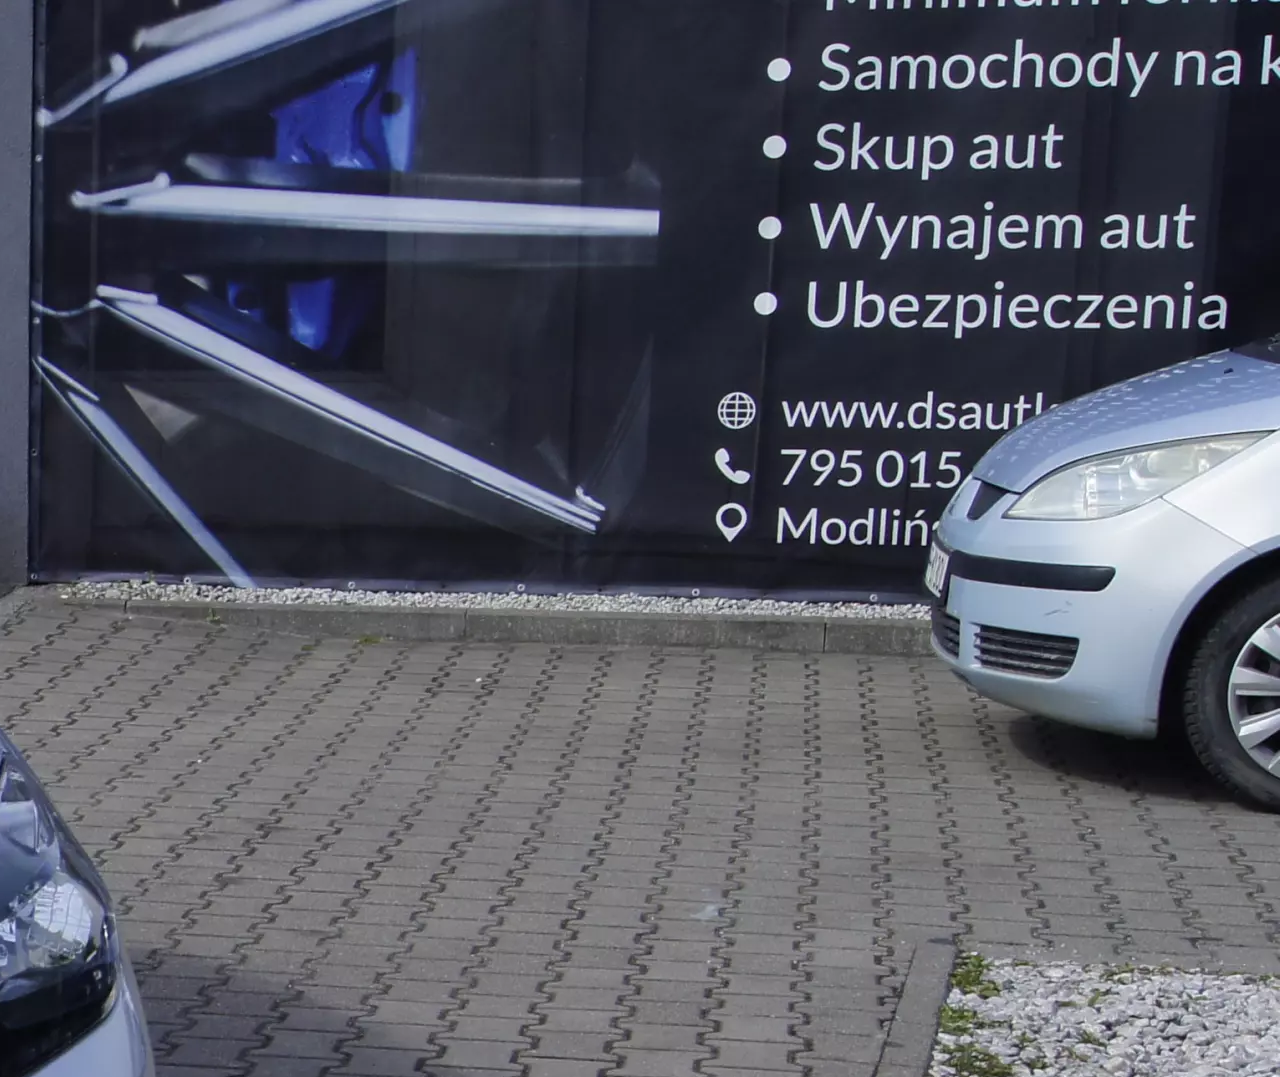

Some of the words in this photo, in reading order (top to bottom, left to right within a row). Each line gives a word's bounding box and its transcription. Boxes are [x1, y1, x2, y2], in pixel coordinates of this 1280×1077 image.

[818, 37, 1158, 97] Samochody
[1173, 49, 1241, 86] na
[813, 123, 954, 180] Skup
[969, 124, 1064, 170] aut
[809, 202, 1082, 260] Wynajem
[1099, 204, 1196, 249] aut
[807, 280, 1227, 339] Ubezpieczenia
[781, 391, 1059, 430] www.dsautl
[780, 449, 863, 487] 795
[876, 450, 962, 488] 015
[776, 507, 940, 546] Modliń
